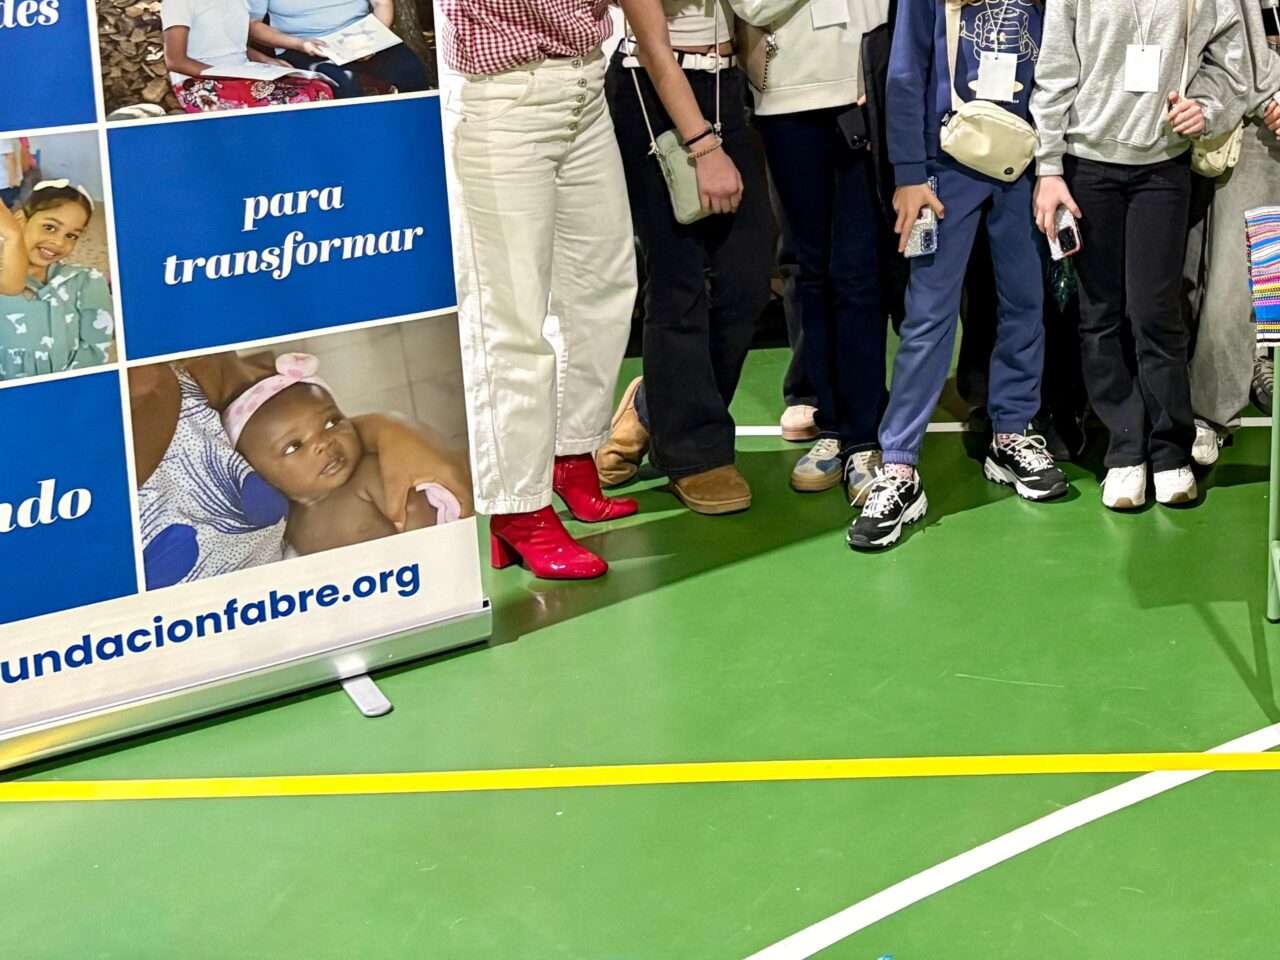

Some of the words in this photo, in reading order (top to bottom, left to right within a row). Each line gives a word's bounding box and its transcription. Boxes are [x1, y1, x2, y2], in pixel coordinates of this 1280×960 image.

[241, 183, 345, 233] para
[162, 226, 425, 287] transformar
[1, 563, 421, 684] undacionfabre.org
